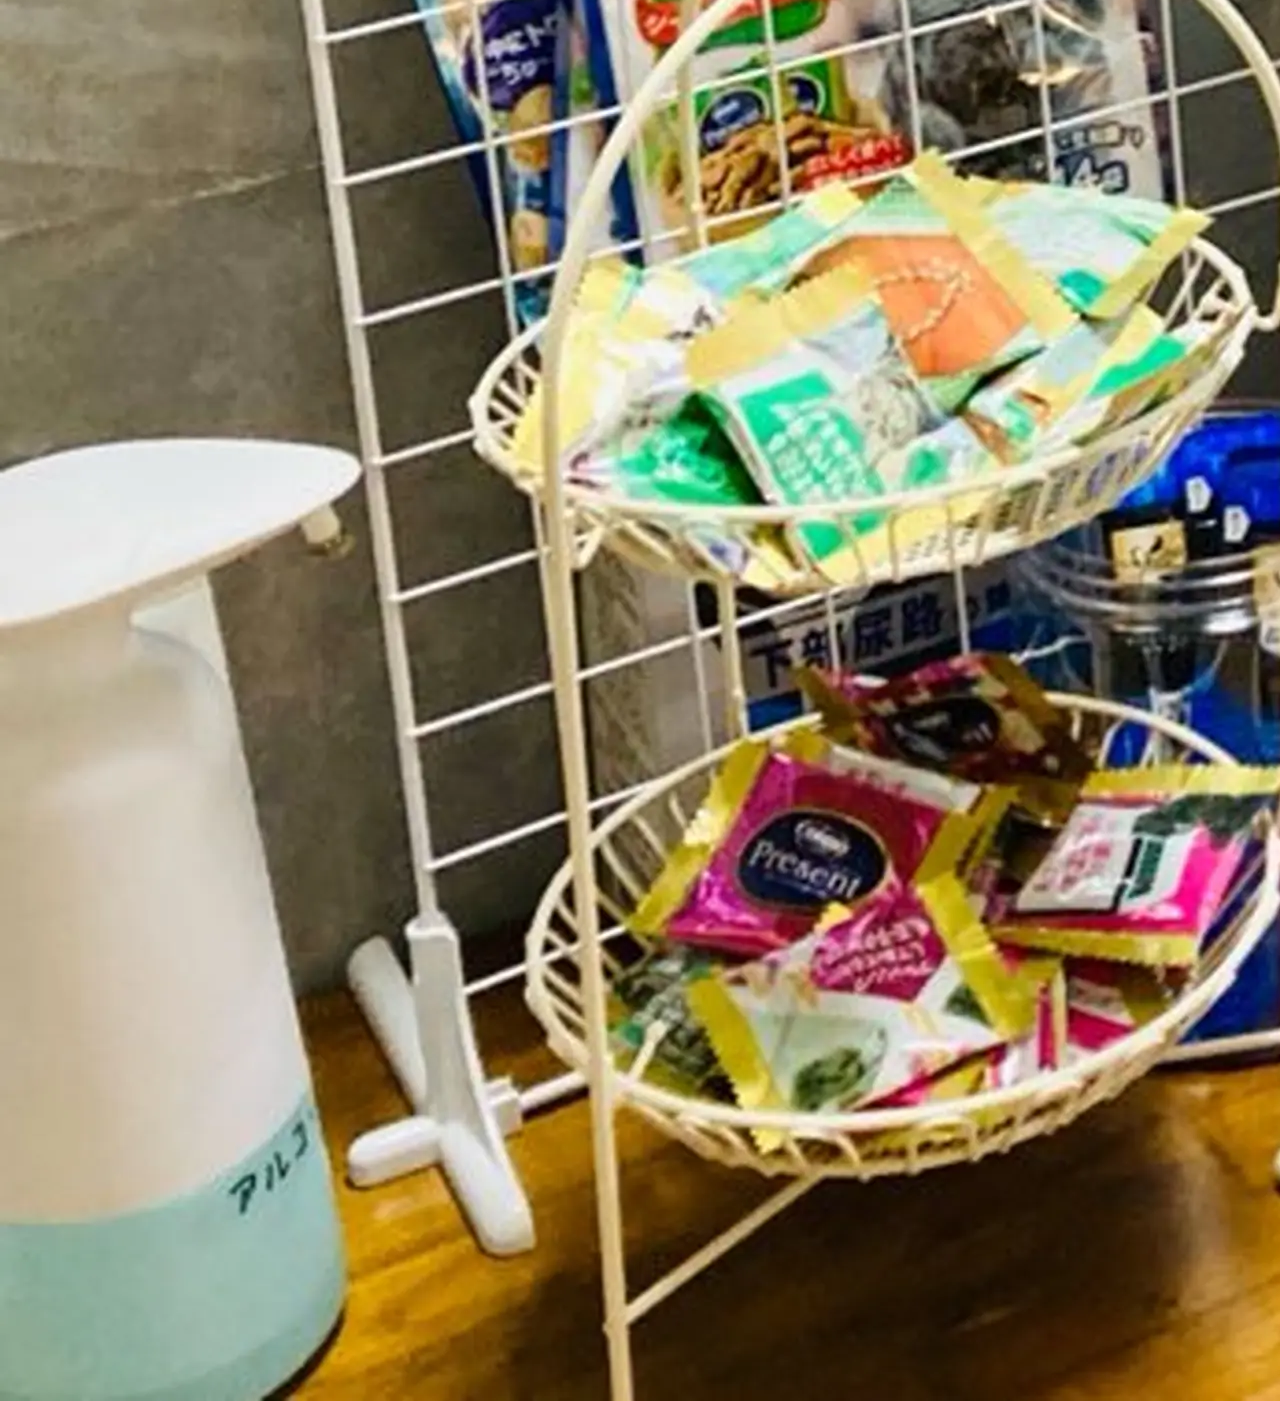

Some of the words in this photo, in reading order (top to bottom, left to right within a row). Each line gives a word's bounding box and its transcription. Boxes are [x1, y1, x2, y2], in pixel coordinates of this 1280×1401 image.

[747, 836, 865, 899] Present
[228, 1110, 314, 1216] アルコ
